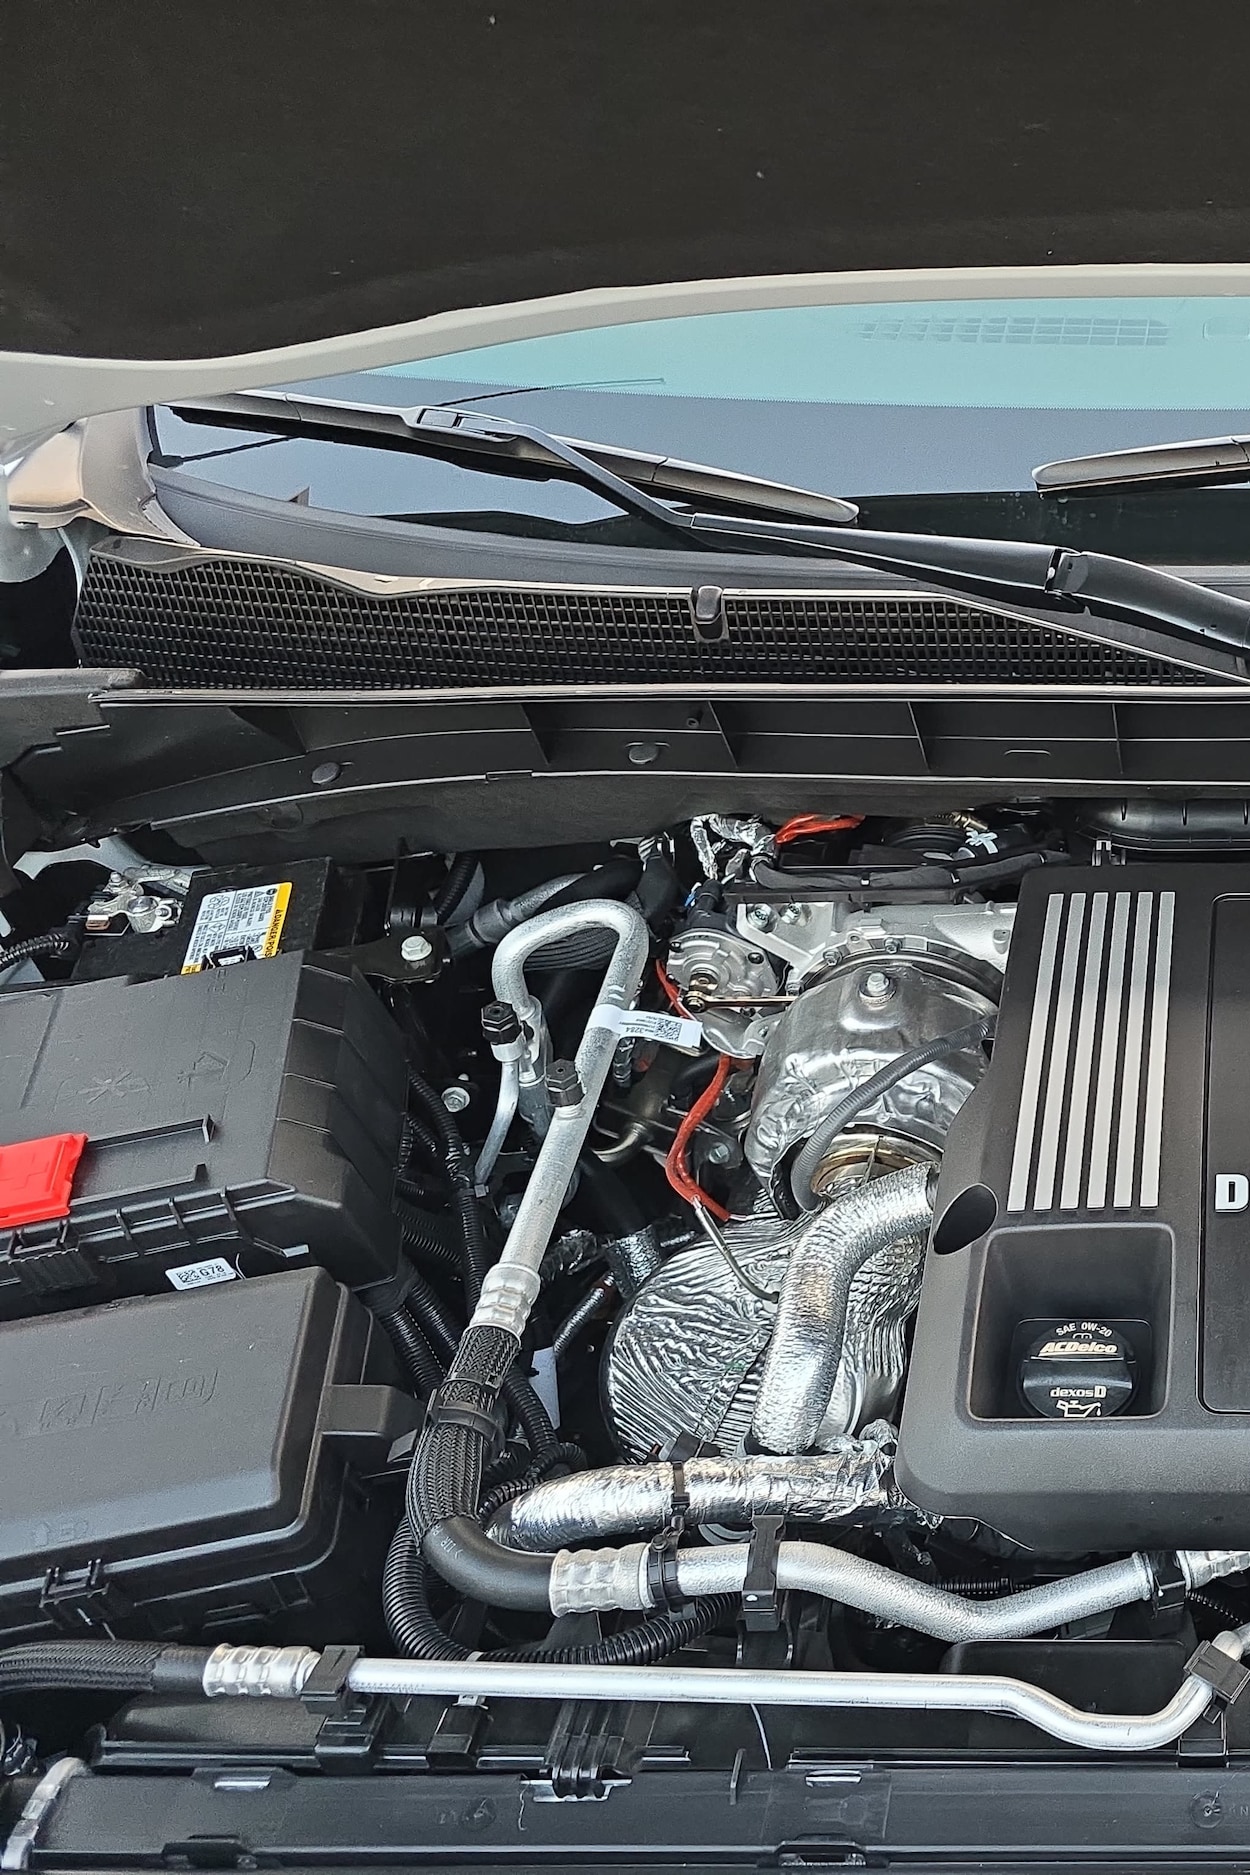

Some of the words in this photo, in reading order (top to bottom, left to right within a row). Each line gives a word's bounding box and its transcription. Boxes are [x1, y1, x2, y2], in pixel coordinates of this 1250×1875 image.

[199, 1265, 225, 1277] G78
[1056, 1322, 1077, 1336] SAE
[1081, 1322, 1113, 1338] 0W-20
[1038, 1341, 1118, 1355] ACDelco
